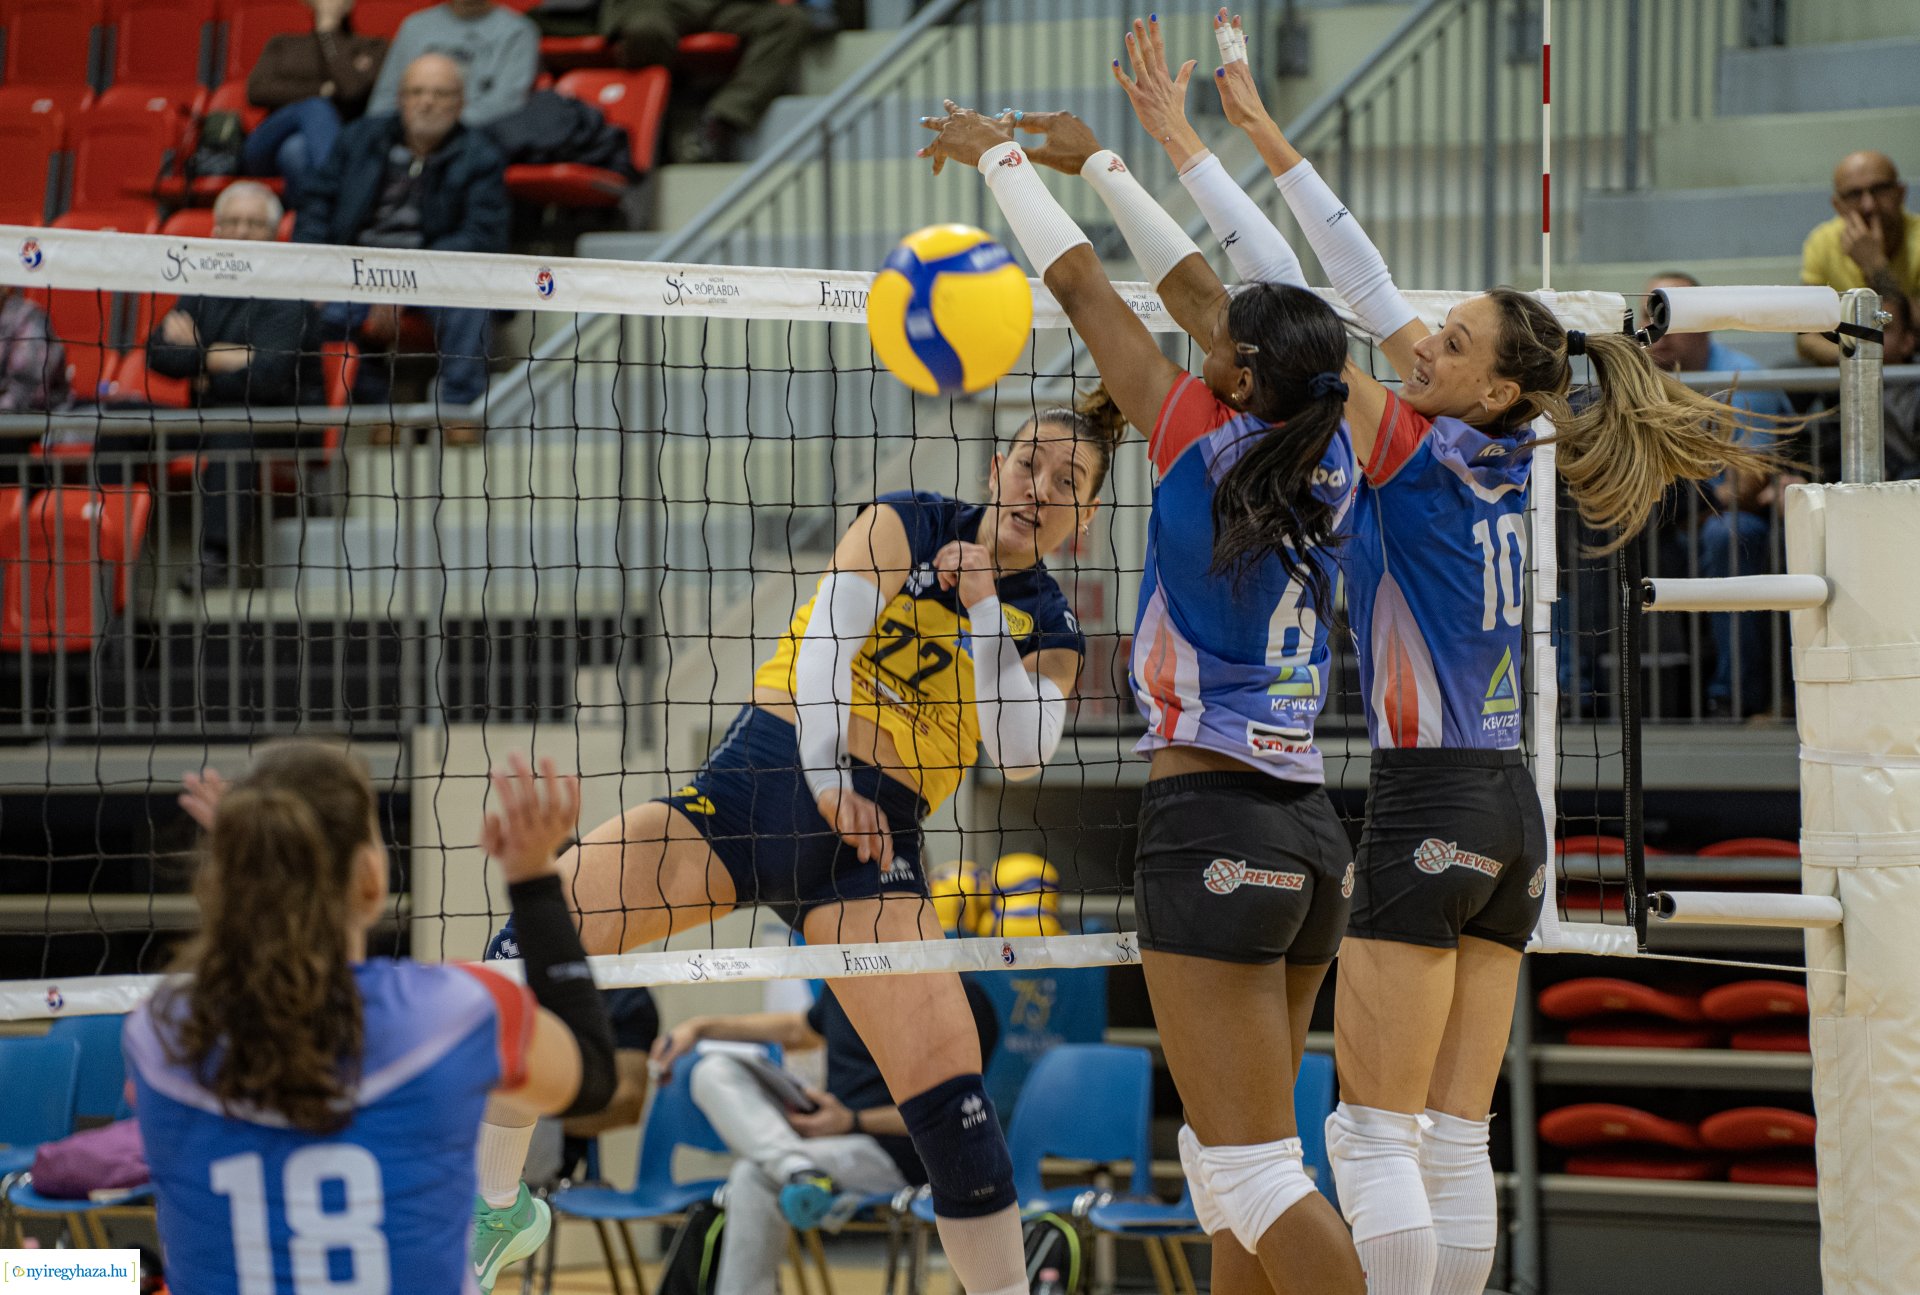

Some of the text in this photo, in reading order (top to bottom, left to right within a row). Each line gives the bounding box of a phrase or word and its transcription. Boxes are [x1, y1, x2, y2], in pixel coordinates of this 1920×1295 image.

[694, 281, 740, 297] RÖPLABDA
[1472, 513, 1527, 631] 10
[1265, 562, 1316, 667] 6
[1242, 869, 1304, 888] REVESZ
[1453, 851, 1502, 876] REVESZ
[209, 1142, 391, 1295] 18
